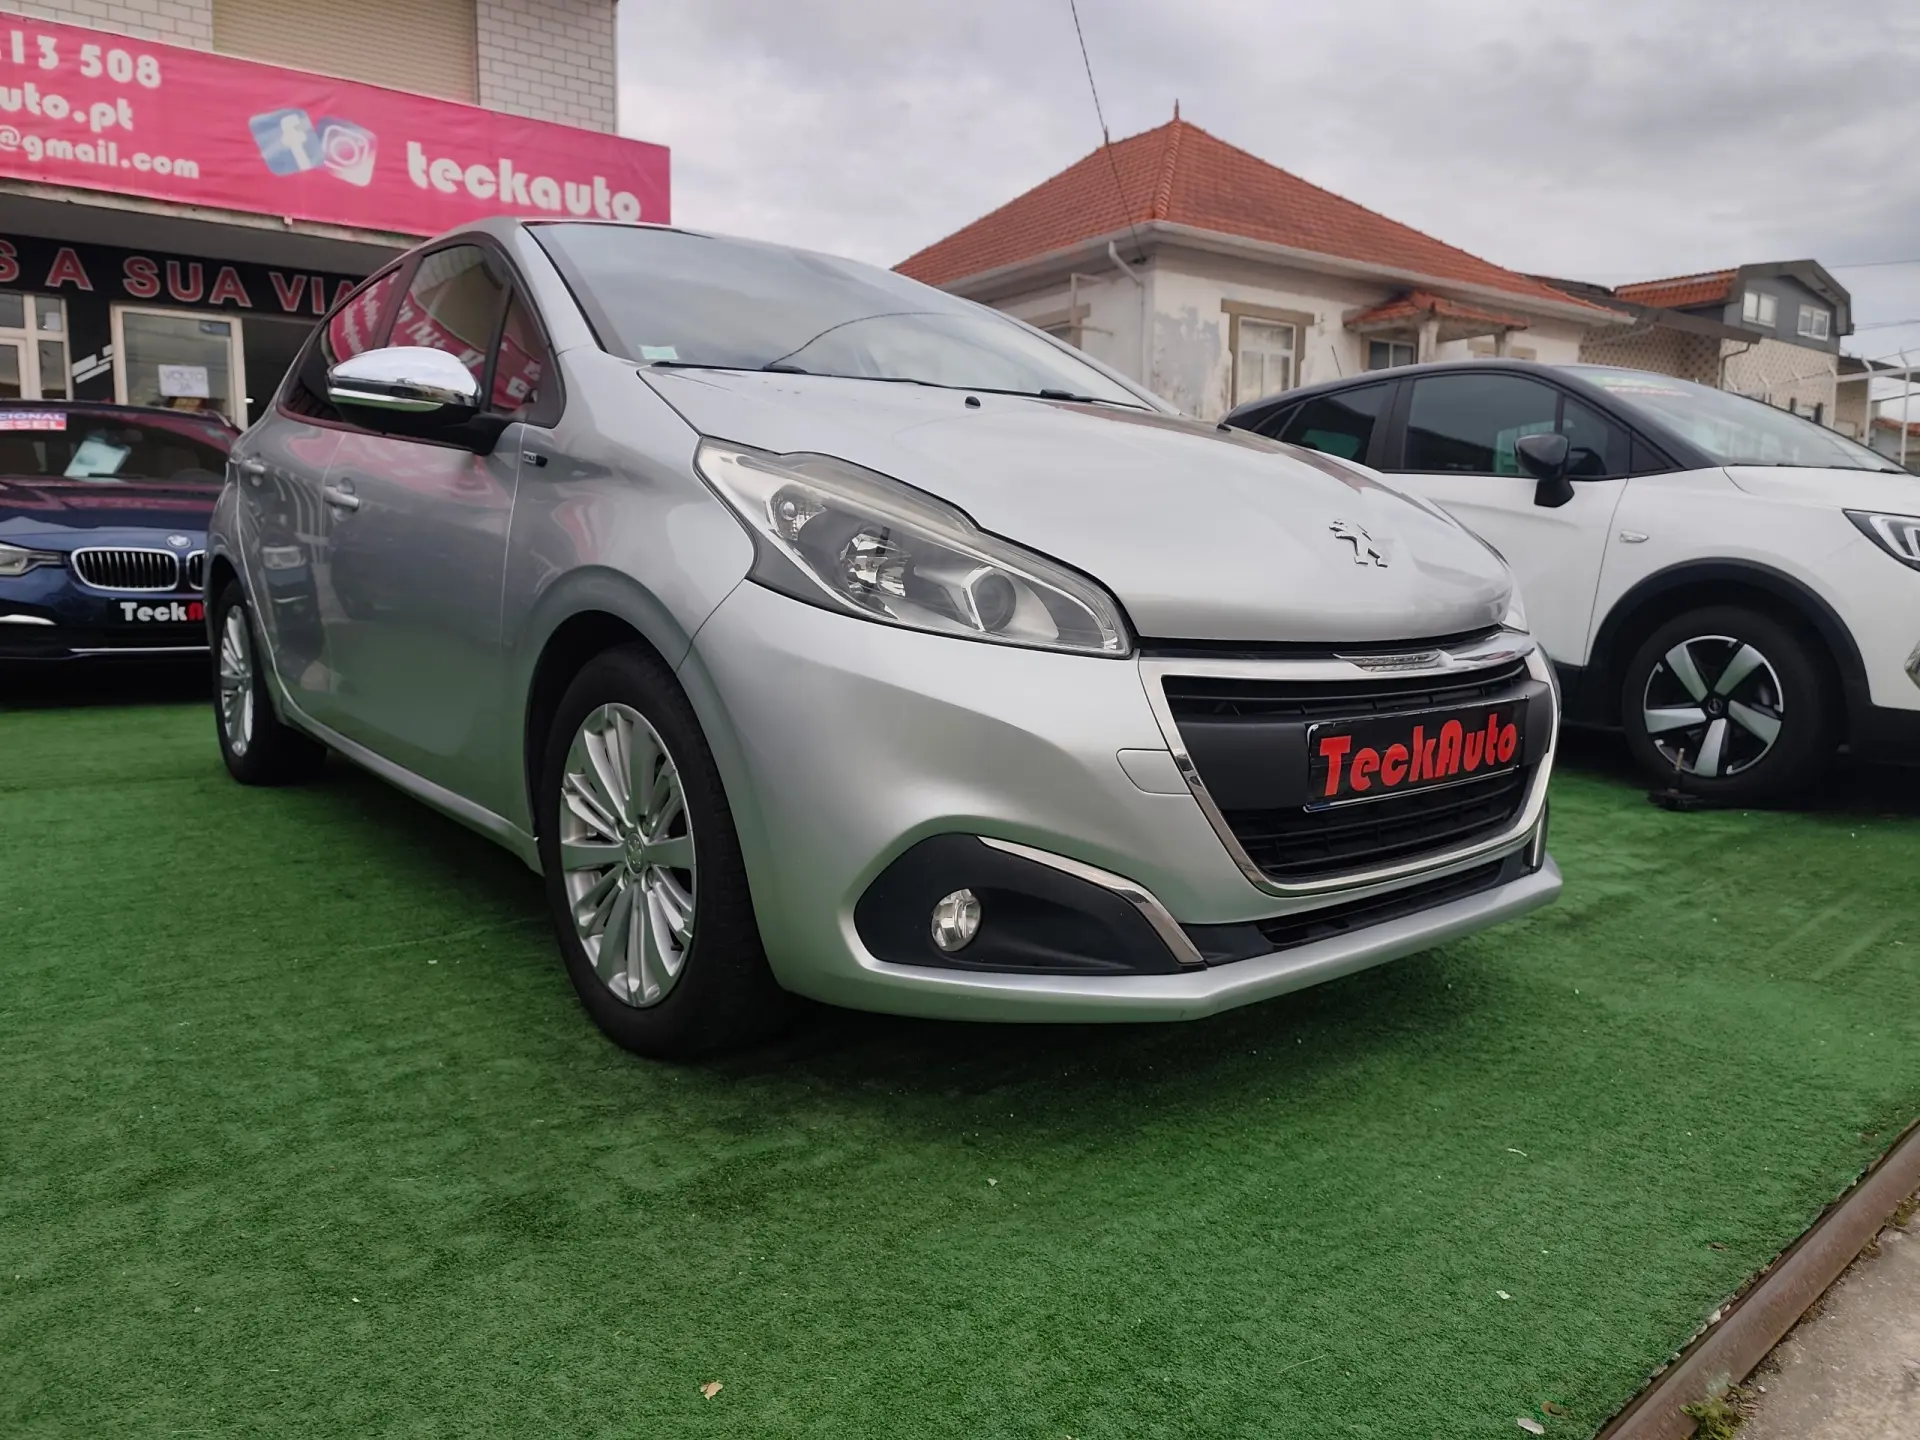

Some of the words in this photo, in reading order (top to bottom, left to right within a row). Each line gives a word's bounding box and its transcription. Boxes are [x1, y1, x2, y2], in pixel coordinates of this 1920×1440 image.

[80, 44, 162, 88] 508
[0, 125, 200, 179] @gmail.com
[406, 140, 641, 222] teckauto
[45, 247, 94, 291] A
[122, 256, 252, 308] SUA
[1319, 713, 1517, 796] TeckAuto
